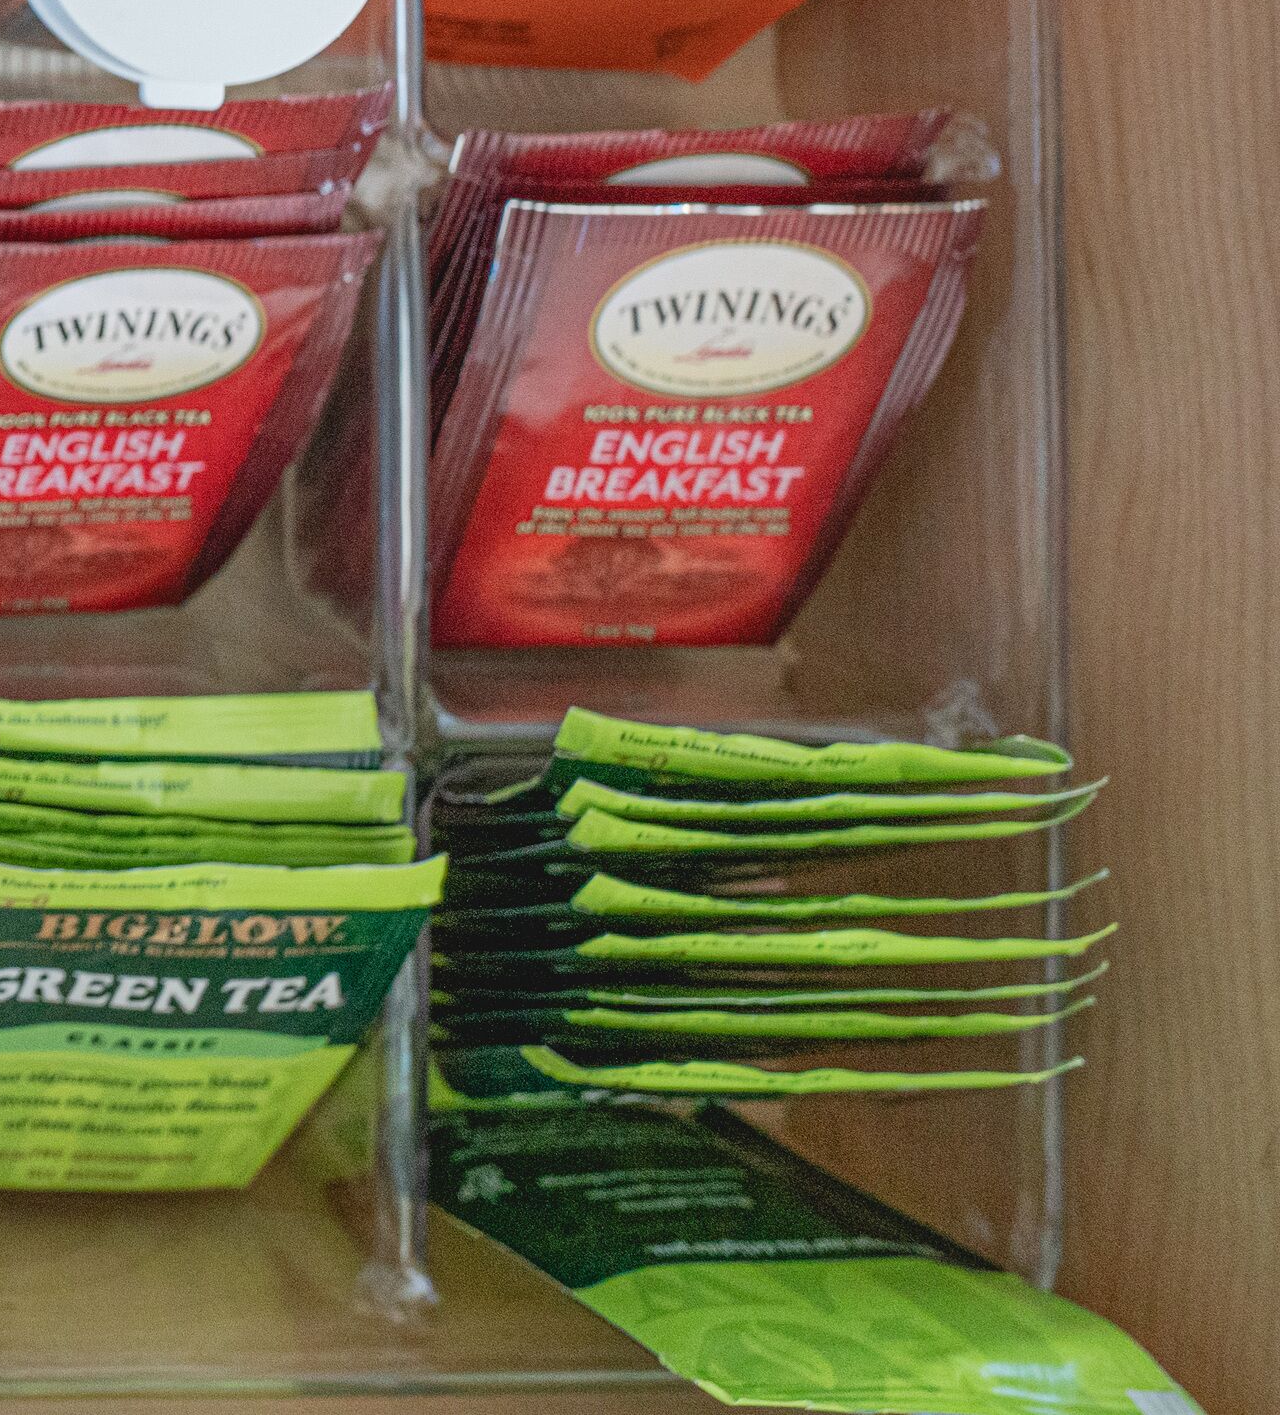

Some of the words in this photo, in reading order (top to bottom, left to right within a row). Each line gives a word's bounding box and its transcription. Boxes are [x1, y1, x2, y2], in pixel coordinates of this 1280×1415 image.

[619, 288, 843, 339] TWININGS
[22, 309, 246, 354] TWININGS
[703, 406, 769, 424] BLACK
[777, 406, 814, 423] TEA
[1, 431, 186, 464] ENGLISH
[589, 430, 787, 465] ENGLISH
[544, 466, 805, 501] BREAKFAST
[36, 914, 347, 944] BIGELOW
[219, 972, 344, 1012] TEA
[67, 1032, 219, 1051] CLASSIC
